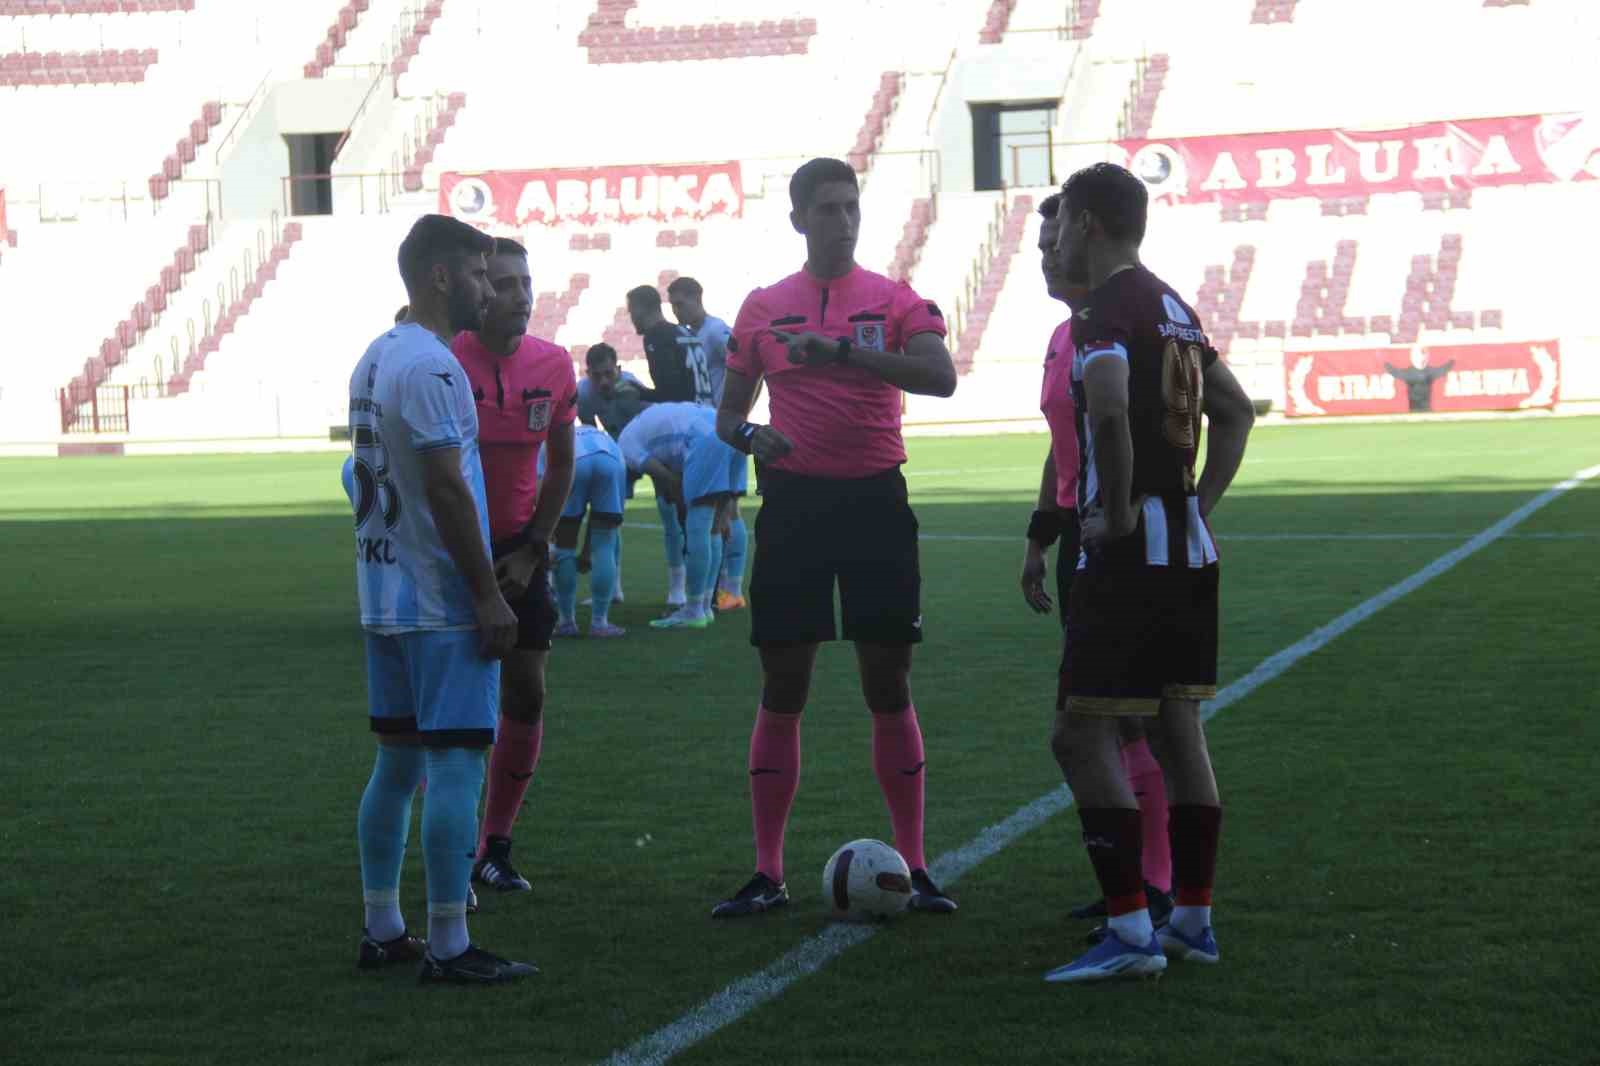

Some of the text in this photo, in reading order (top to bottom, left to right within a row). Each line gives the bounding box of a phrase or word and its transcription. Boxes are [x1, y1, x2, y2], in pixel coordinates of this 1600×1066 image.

[1201, 134, 1521, 191] ABLUKA
[514, 172, 741, 224] ABLUKA
[1318, 368, 1531, 401] ULTRAS ABLUKA
